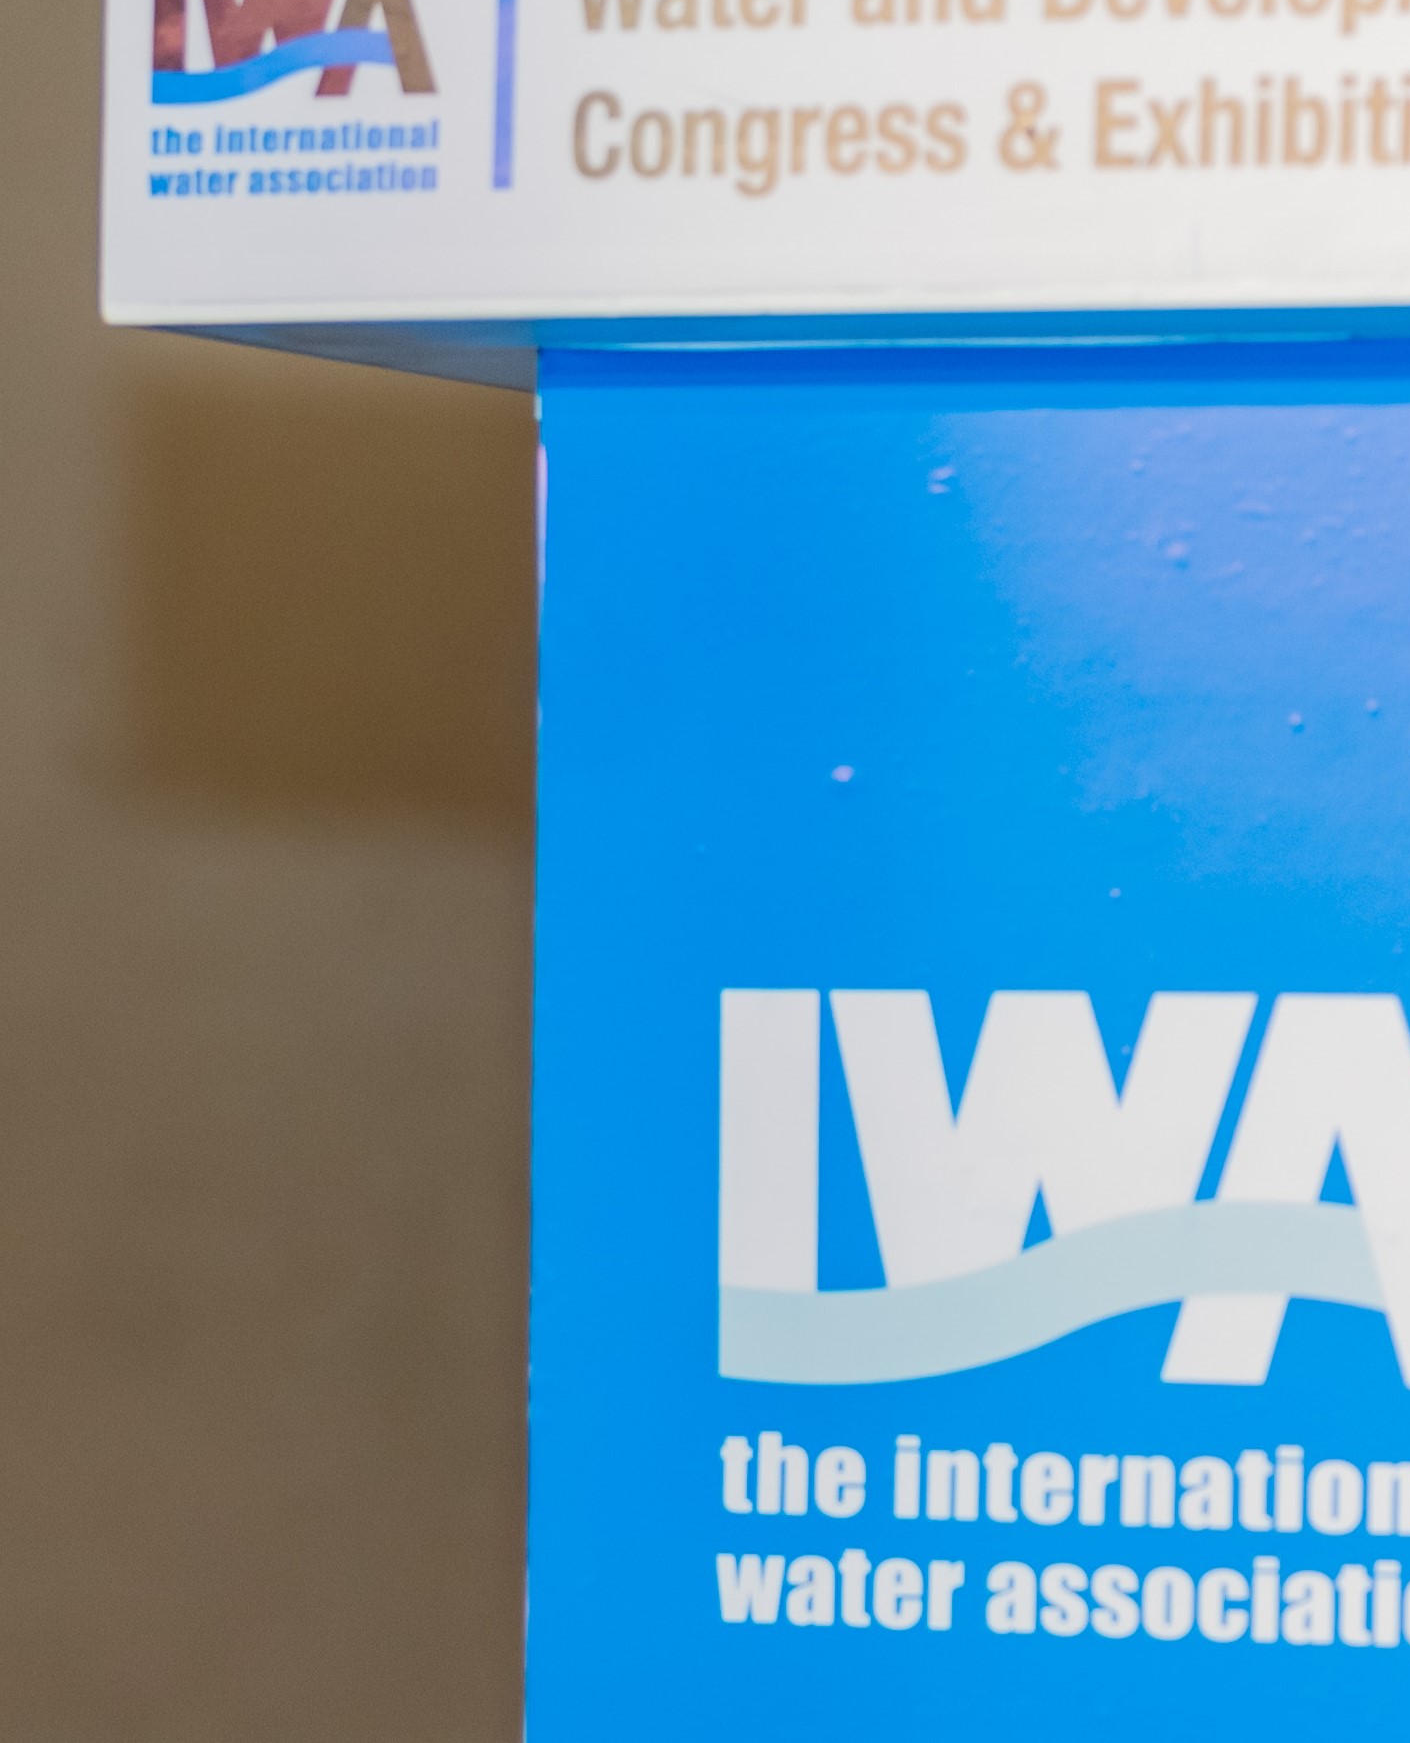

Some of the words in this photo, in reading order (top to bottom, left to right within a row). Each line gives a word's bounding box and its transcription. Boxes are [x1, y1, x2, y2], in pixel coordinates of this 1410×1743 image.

[149, 169, 237, 196] water
[249, 162, 437, 196] association
[151, 125, 202, 155] the
[214, 121, 439, 154] international
[573, 90, 968, 198] Congress
[998, 80, 1061, 172] &
[719, 1431, 867, 1518] the
[715, 1548, 966, 1631] water
